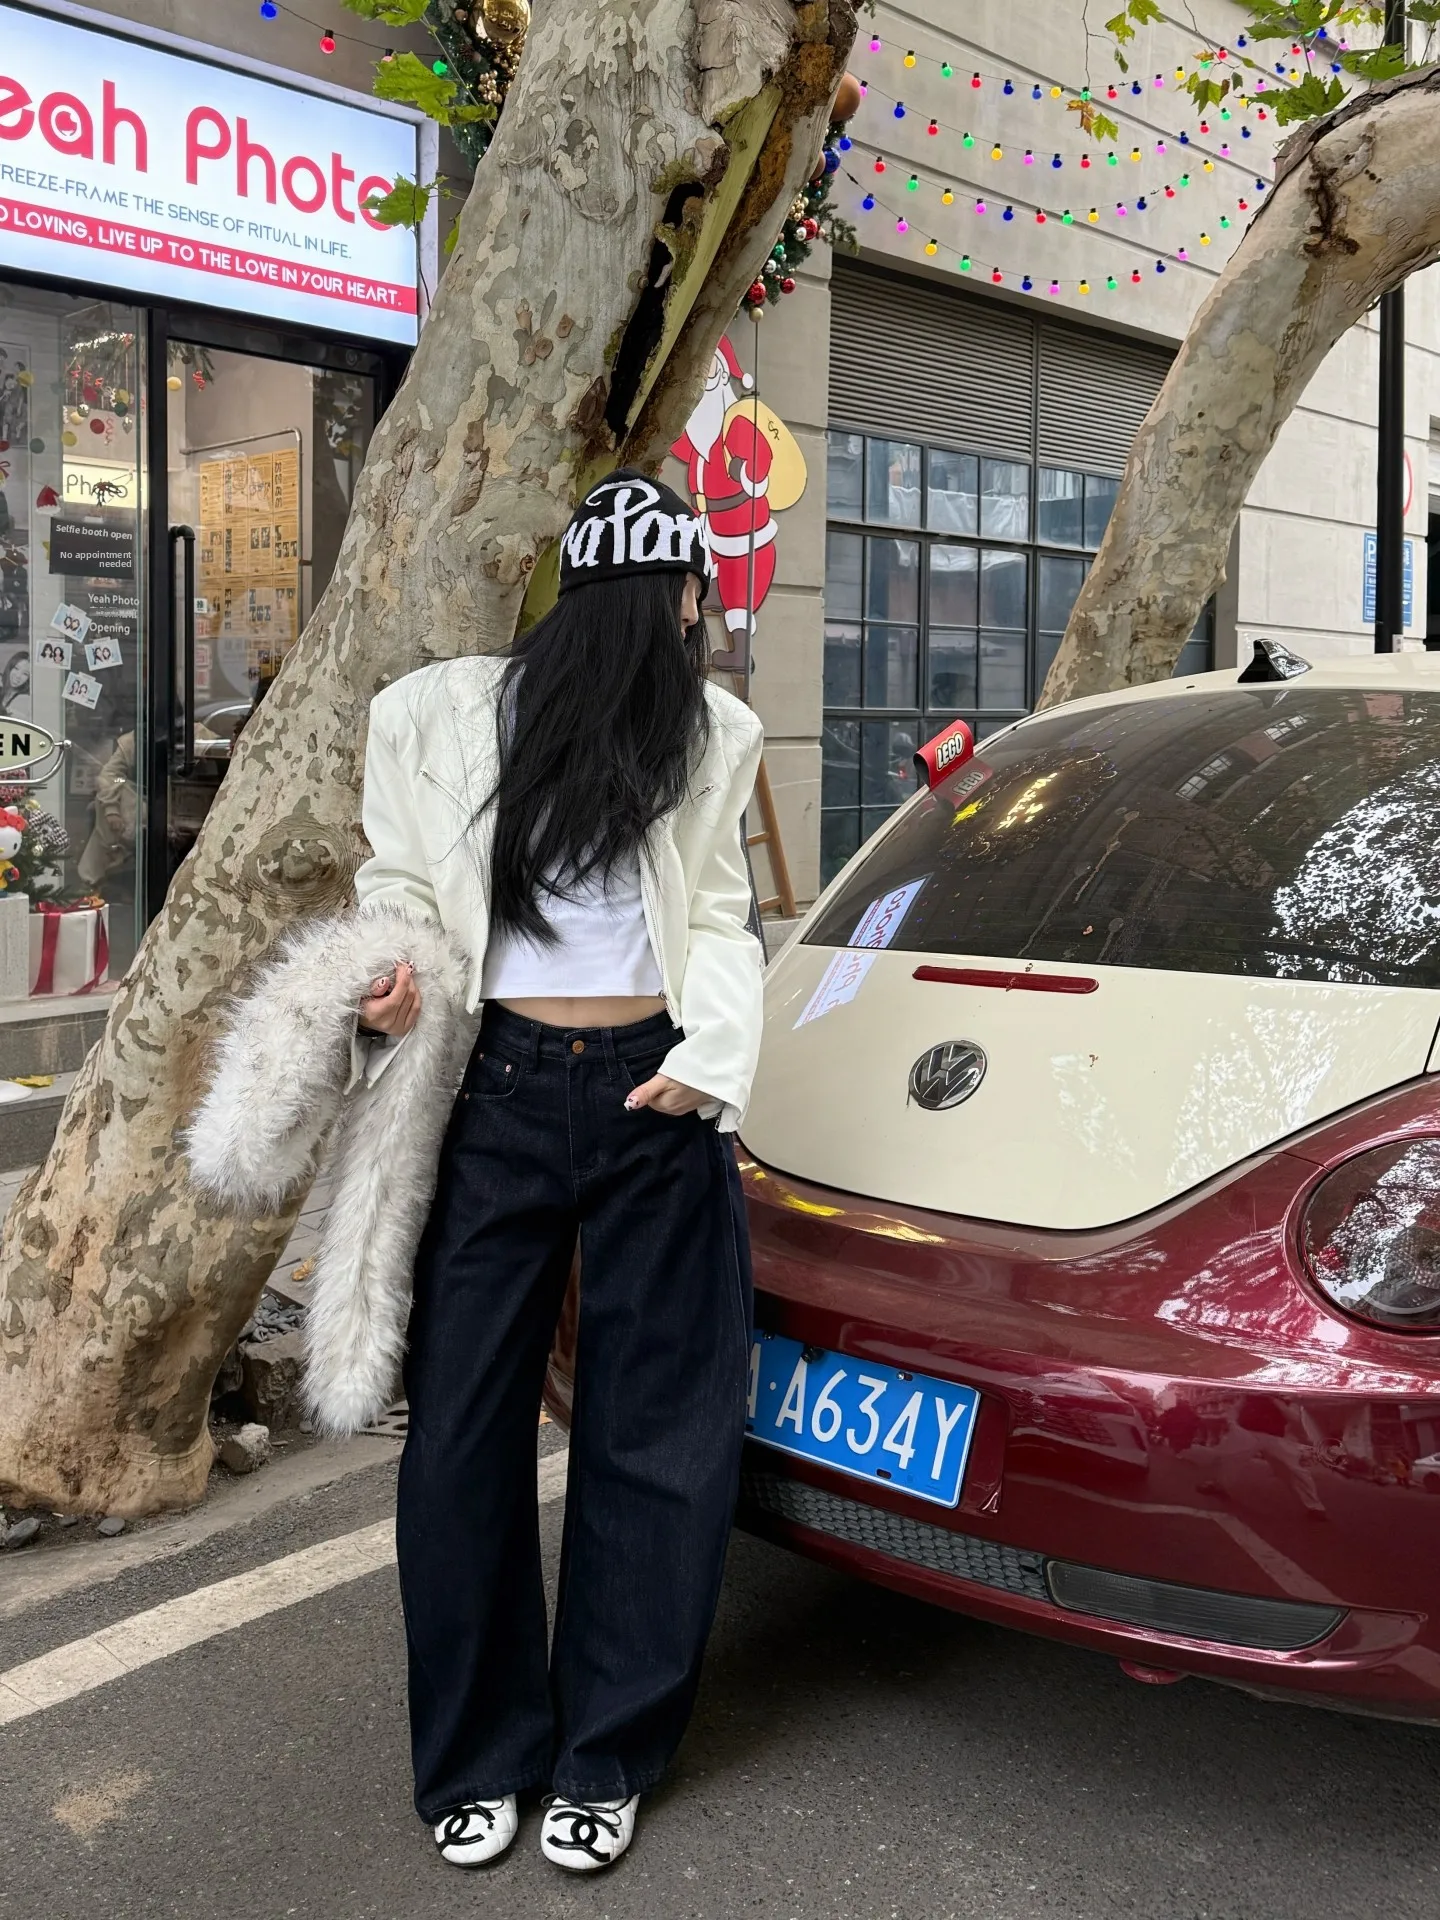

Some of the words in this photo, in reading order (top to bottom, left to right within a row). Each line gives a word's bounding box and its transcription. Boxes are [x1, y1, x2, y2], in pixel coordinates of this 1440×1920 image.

[186, 106, 398, 232] Photo
[0, 163, 129, 208] REEZE-FRAME
[133, 194, 164, 216] THE
[168, 204, 220, 229] SENSE
[223, 216, 245, 234] OF
[248, 222, 301, 248] RITUAL
[304, 235, 318, 251] IN
[321, 239, 352, 259] LIFE.
[13, 208, 93, 244] LOVING,
[99, 226, 136, 250] LIVE
[140, 235, 163, 254] UP
[168, 241, 195, 262] TO
[199, 248, 231, 271] THE
[235, 257, 278, 281] LOVE
[282, 267, 298, 285] IN
[301, 270, 343, 294] YOUR
[347, 280, 402, 306] HEART.
[67, 474, 128, 499] Pho
[56, 524, 81, 535] Selfie
[82, 527, 109, 538] booth
[111, 531, 133, 540] open
[75, 550, 132, 560] appointment
[99, 559, 132, 568] needed
[88, 593, 110, 604] Yeah
[112, 594, 140, 606] Photo
[89, 621, 131, 636] Opening
[936, 732, 964, 770] LEGO
